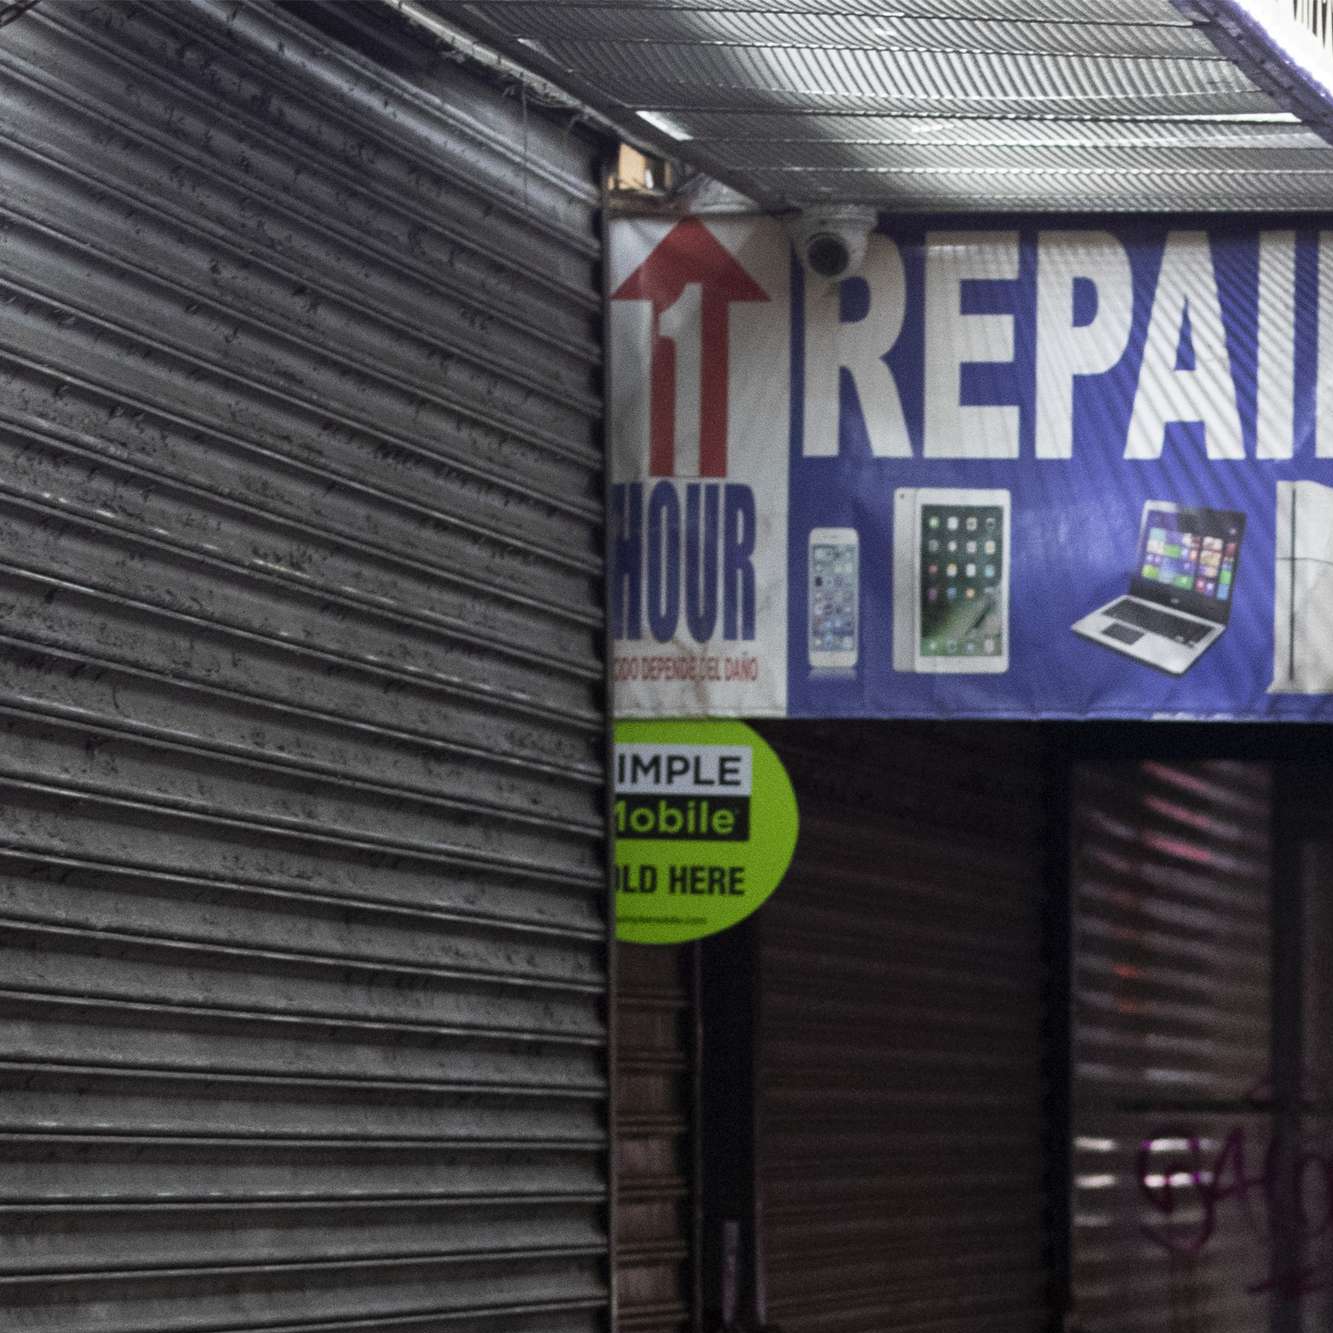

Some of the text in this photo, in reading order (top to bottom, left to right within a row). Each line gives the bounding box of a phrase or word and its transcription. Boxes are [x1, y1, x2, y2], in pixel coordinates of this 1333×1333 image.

[659, 281, 703, 477] 1
[611, 481, 756, 643] HOUR
[617, 753, 742, 786] IMPLE
[615, 864, 746, 896] LD HERE
